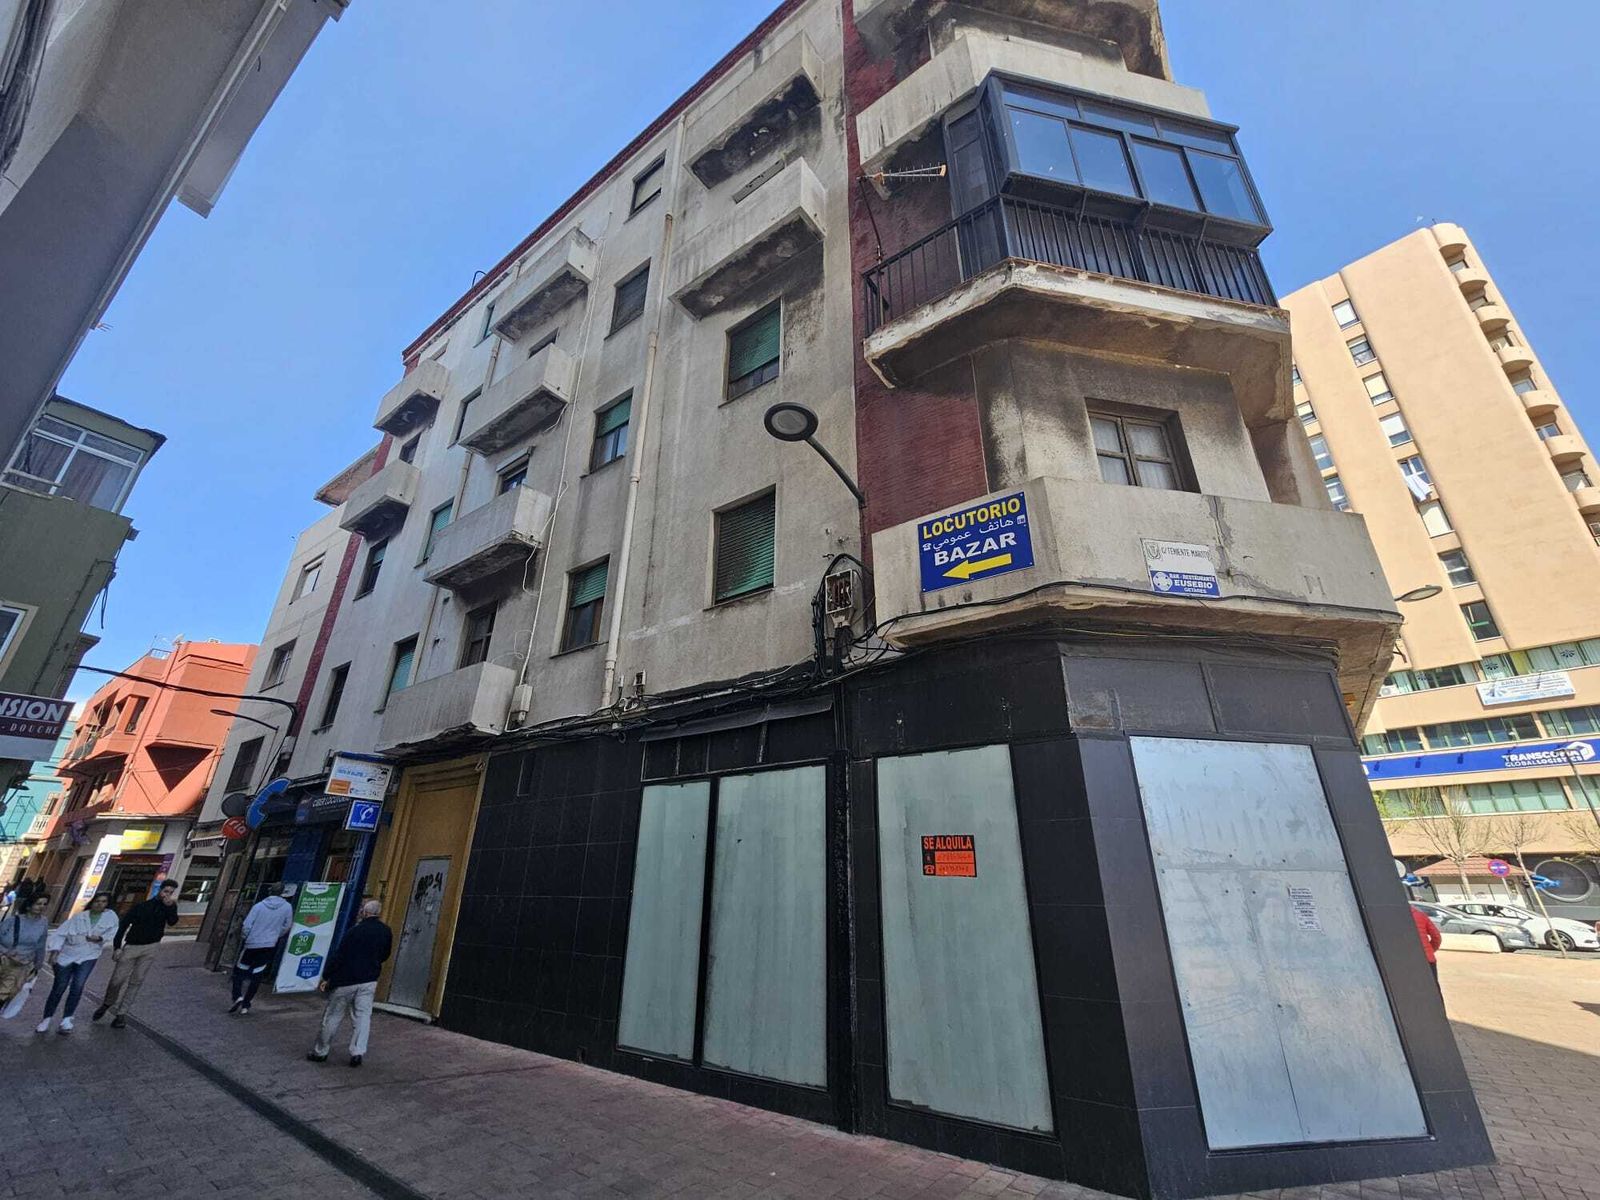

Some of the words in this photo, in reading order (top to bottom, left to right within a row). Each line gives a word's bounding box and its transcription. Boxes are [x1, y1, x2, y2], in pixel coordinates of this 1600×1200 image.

[923, 498, 1020, 539] LOCUTORIO
[979, 518, 1014, 534] هاتف
[933, 531, 972, 551] عمومي
[934, 532, 1017, 566] BAZAR
[1174, 579, 1213, 589] EUSEBIO
[10, 722, 57, 735] DOUCHE
[923, 837, 934, 850] SE
[936, 836, 973, 850] ALQUILA
